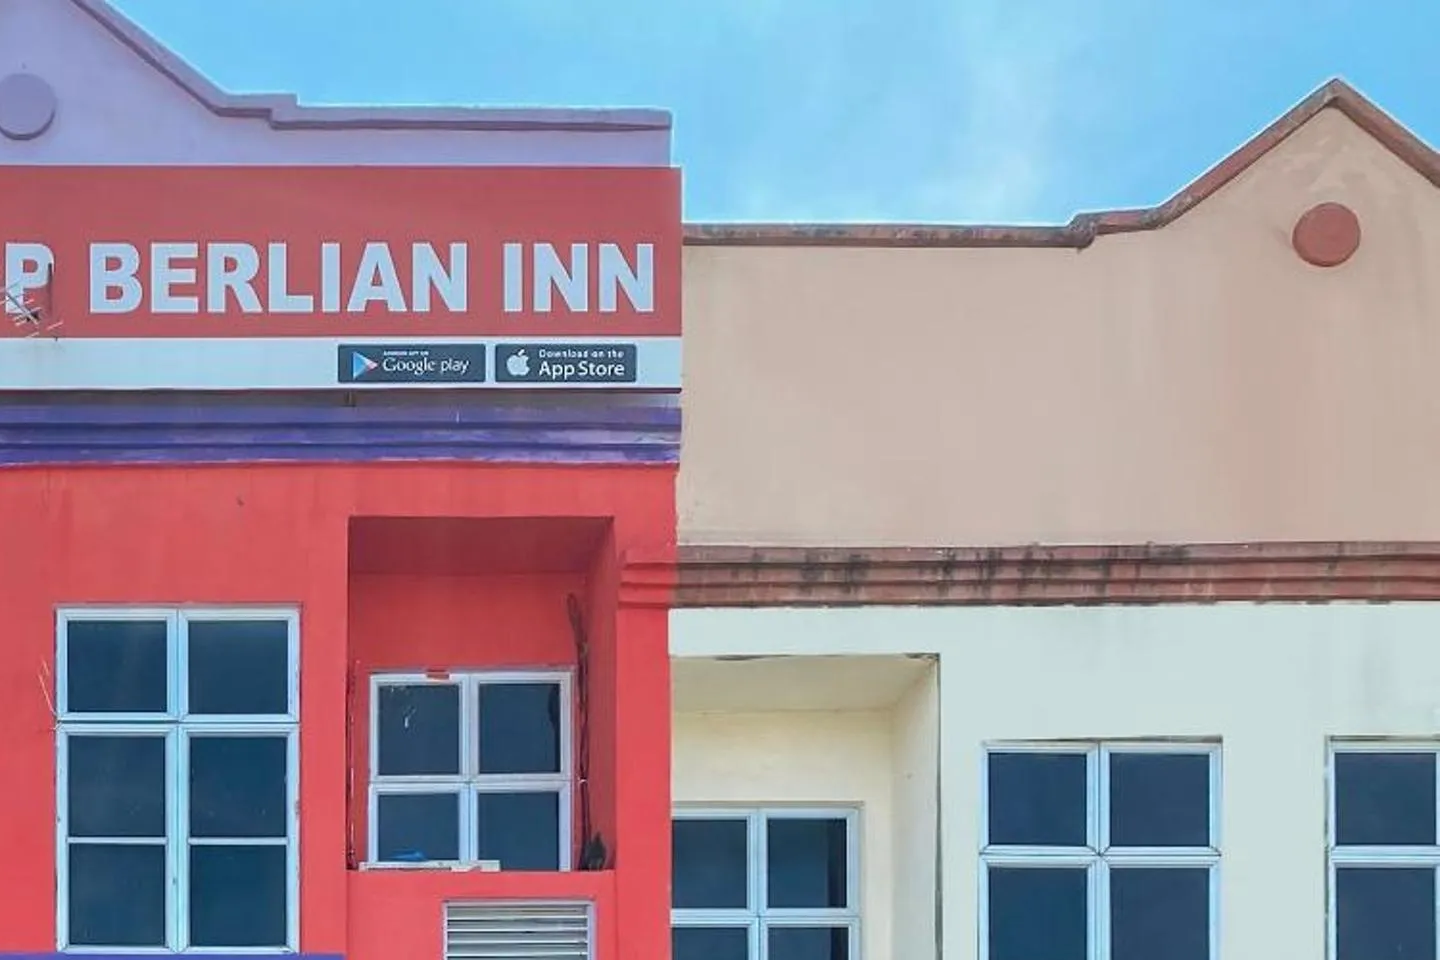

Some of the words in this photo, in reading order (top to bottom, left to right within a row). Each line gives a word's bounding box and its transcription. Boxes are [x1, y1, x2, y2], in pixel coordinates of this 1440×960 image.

[89, 241, 469, 314] BERLIAN
[503, 242, 655, 313] INN
[383, 357, 437, 375] Google
[441, 357, 470, 375] play
[539, 360, 575, 380] App
[577, 360, 625, 376] Store
